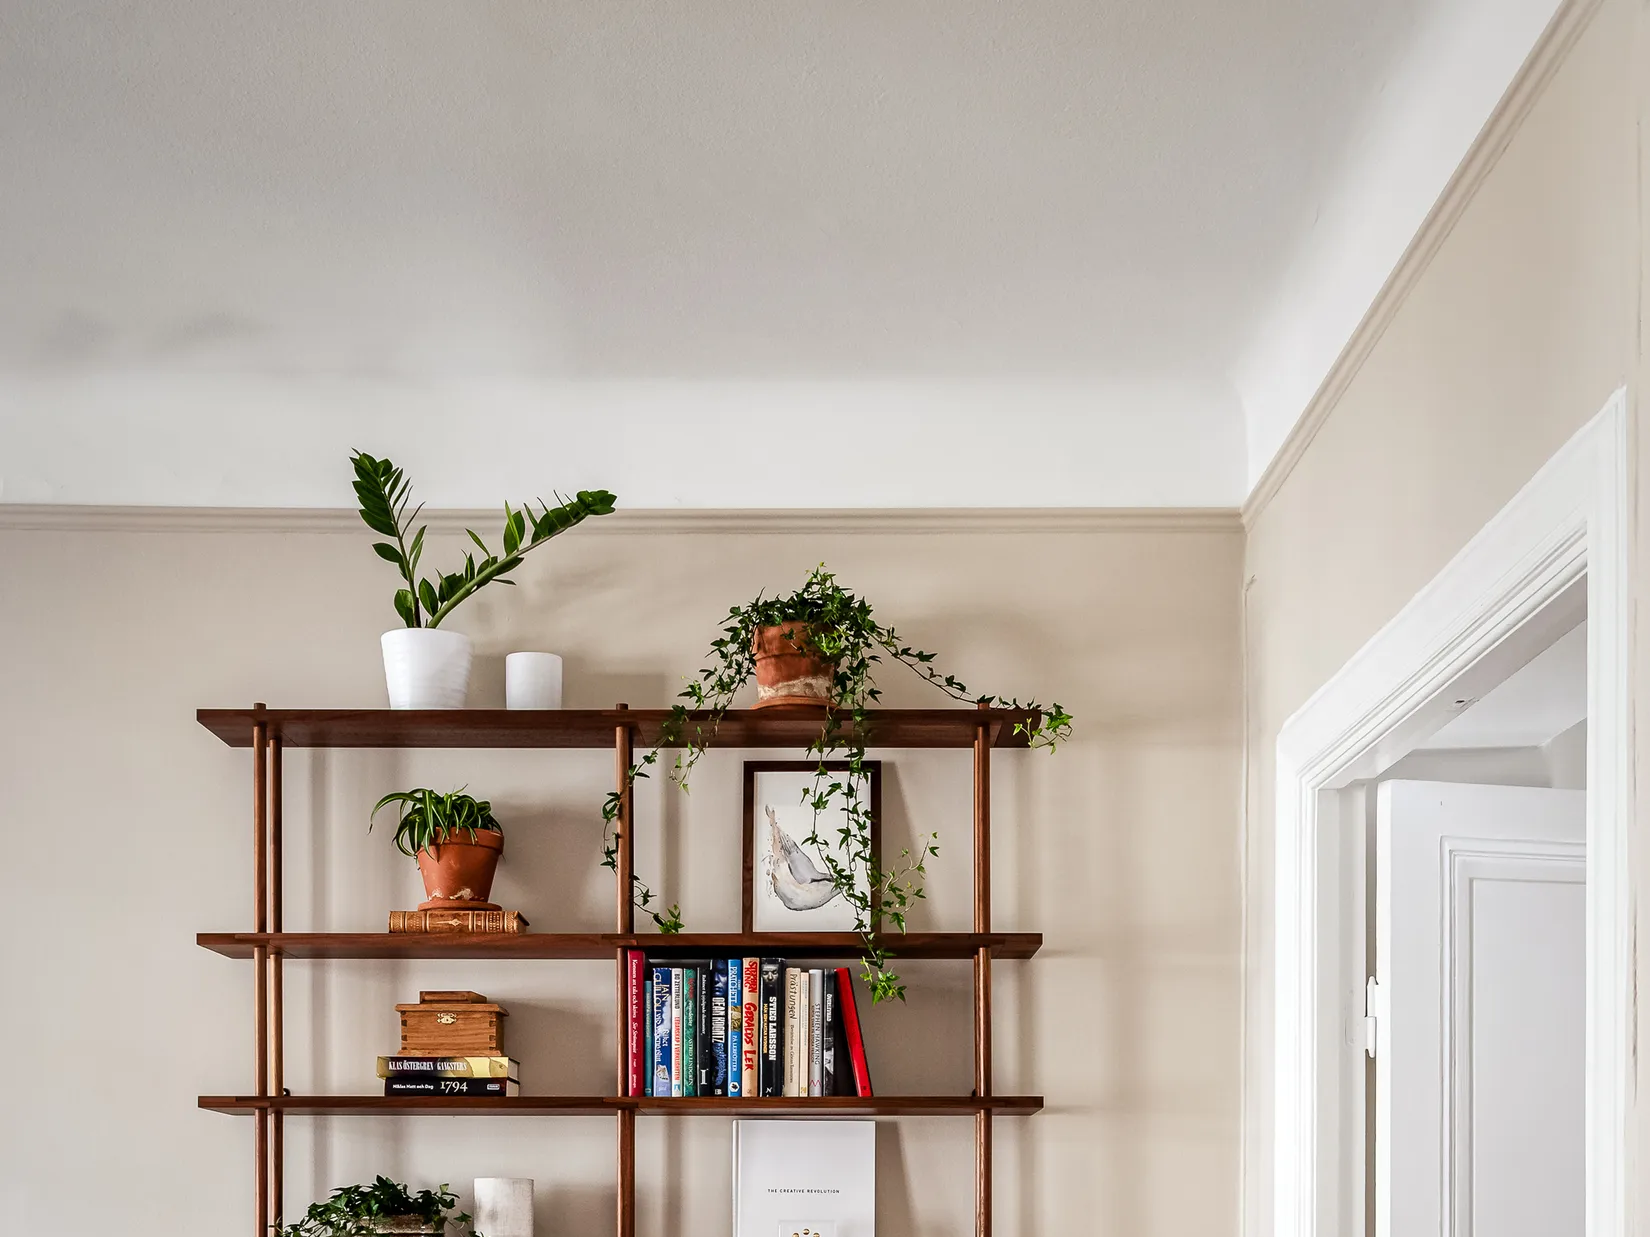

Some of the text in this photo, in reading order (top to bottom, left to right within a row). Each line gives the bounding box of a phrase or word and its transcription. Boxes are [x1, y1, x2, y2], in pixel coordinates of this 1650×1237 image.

[674, 973, 681, 981] BO
[729, 966, 738, 1003] PRATCHETT
[749, 961, 758, 993] STEPHEN
[654, 972, 662, 1013] GUILLOU
[662, 984, 670, 1000] JAN
[712, 996, 726, 1044] DEAN KOONTZ
[768, 996, 777, 1061] STIEG LARSSON
[731, 1034, 738, 1042] PÅ
[744, 1002, 758, 1071] GERALDS LEK
[388, 1059, 468, 1071] KLAS ÖSTERGREN GANGSTERS
[425, 1083, 434, 1091] Dag
[440, 1081, 468, 1094] 1794
